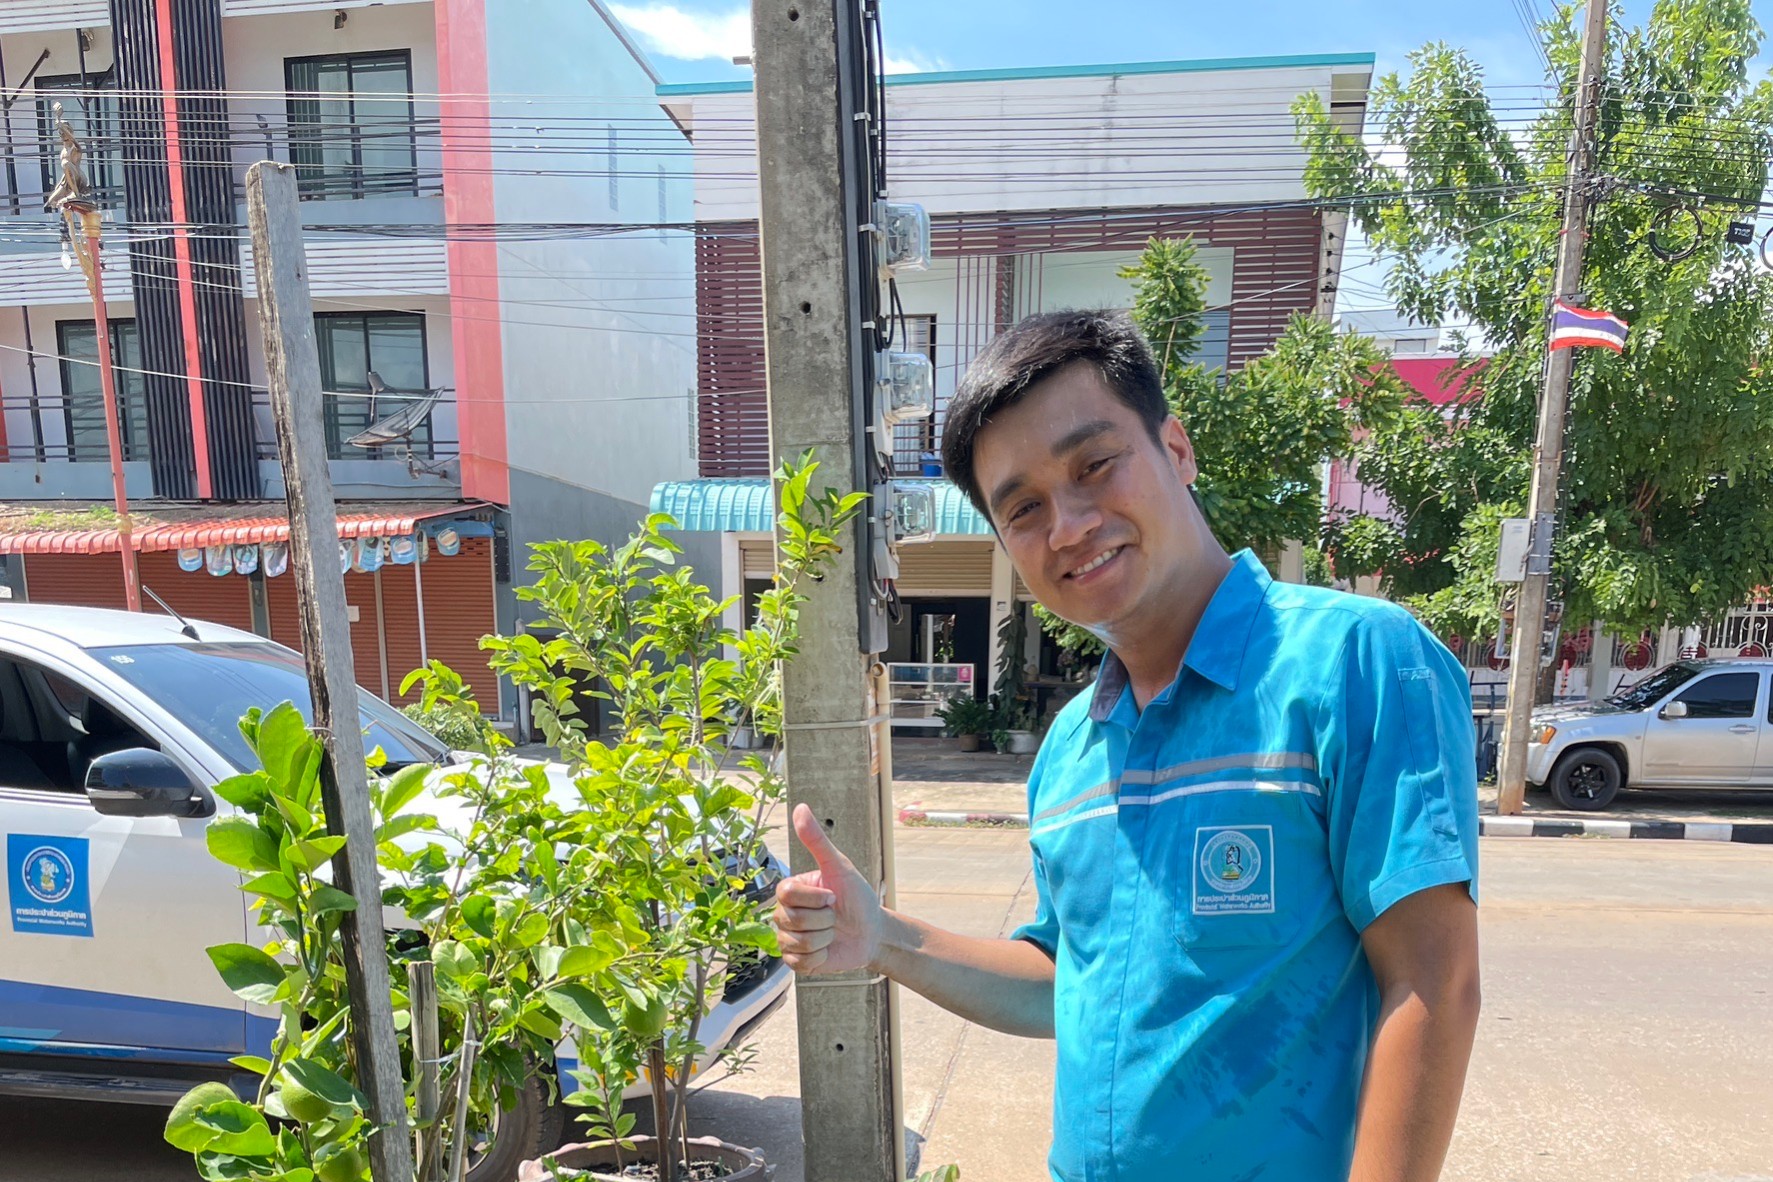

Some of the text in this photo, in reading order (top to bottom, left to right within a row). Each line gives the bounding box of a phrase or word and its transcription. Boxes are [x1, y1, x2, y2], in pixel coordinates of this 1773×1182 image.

[1197, 894, 1268, 903] การประปาส่วนภูมิภาค
[16, 907, 87, 920] การประปาส่วนภูมิภาค
